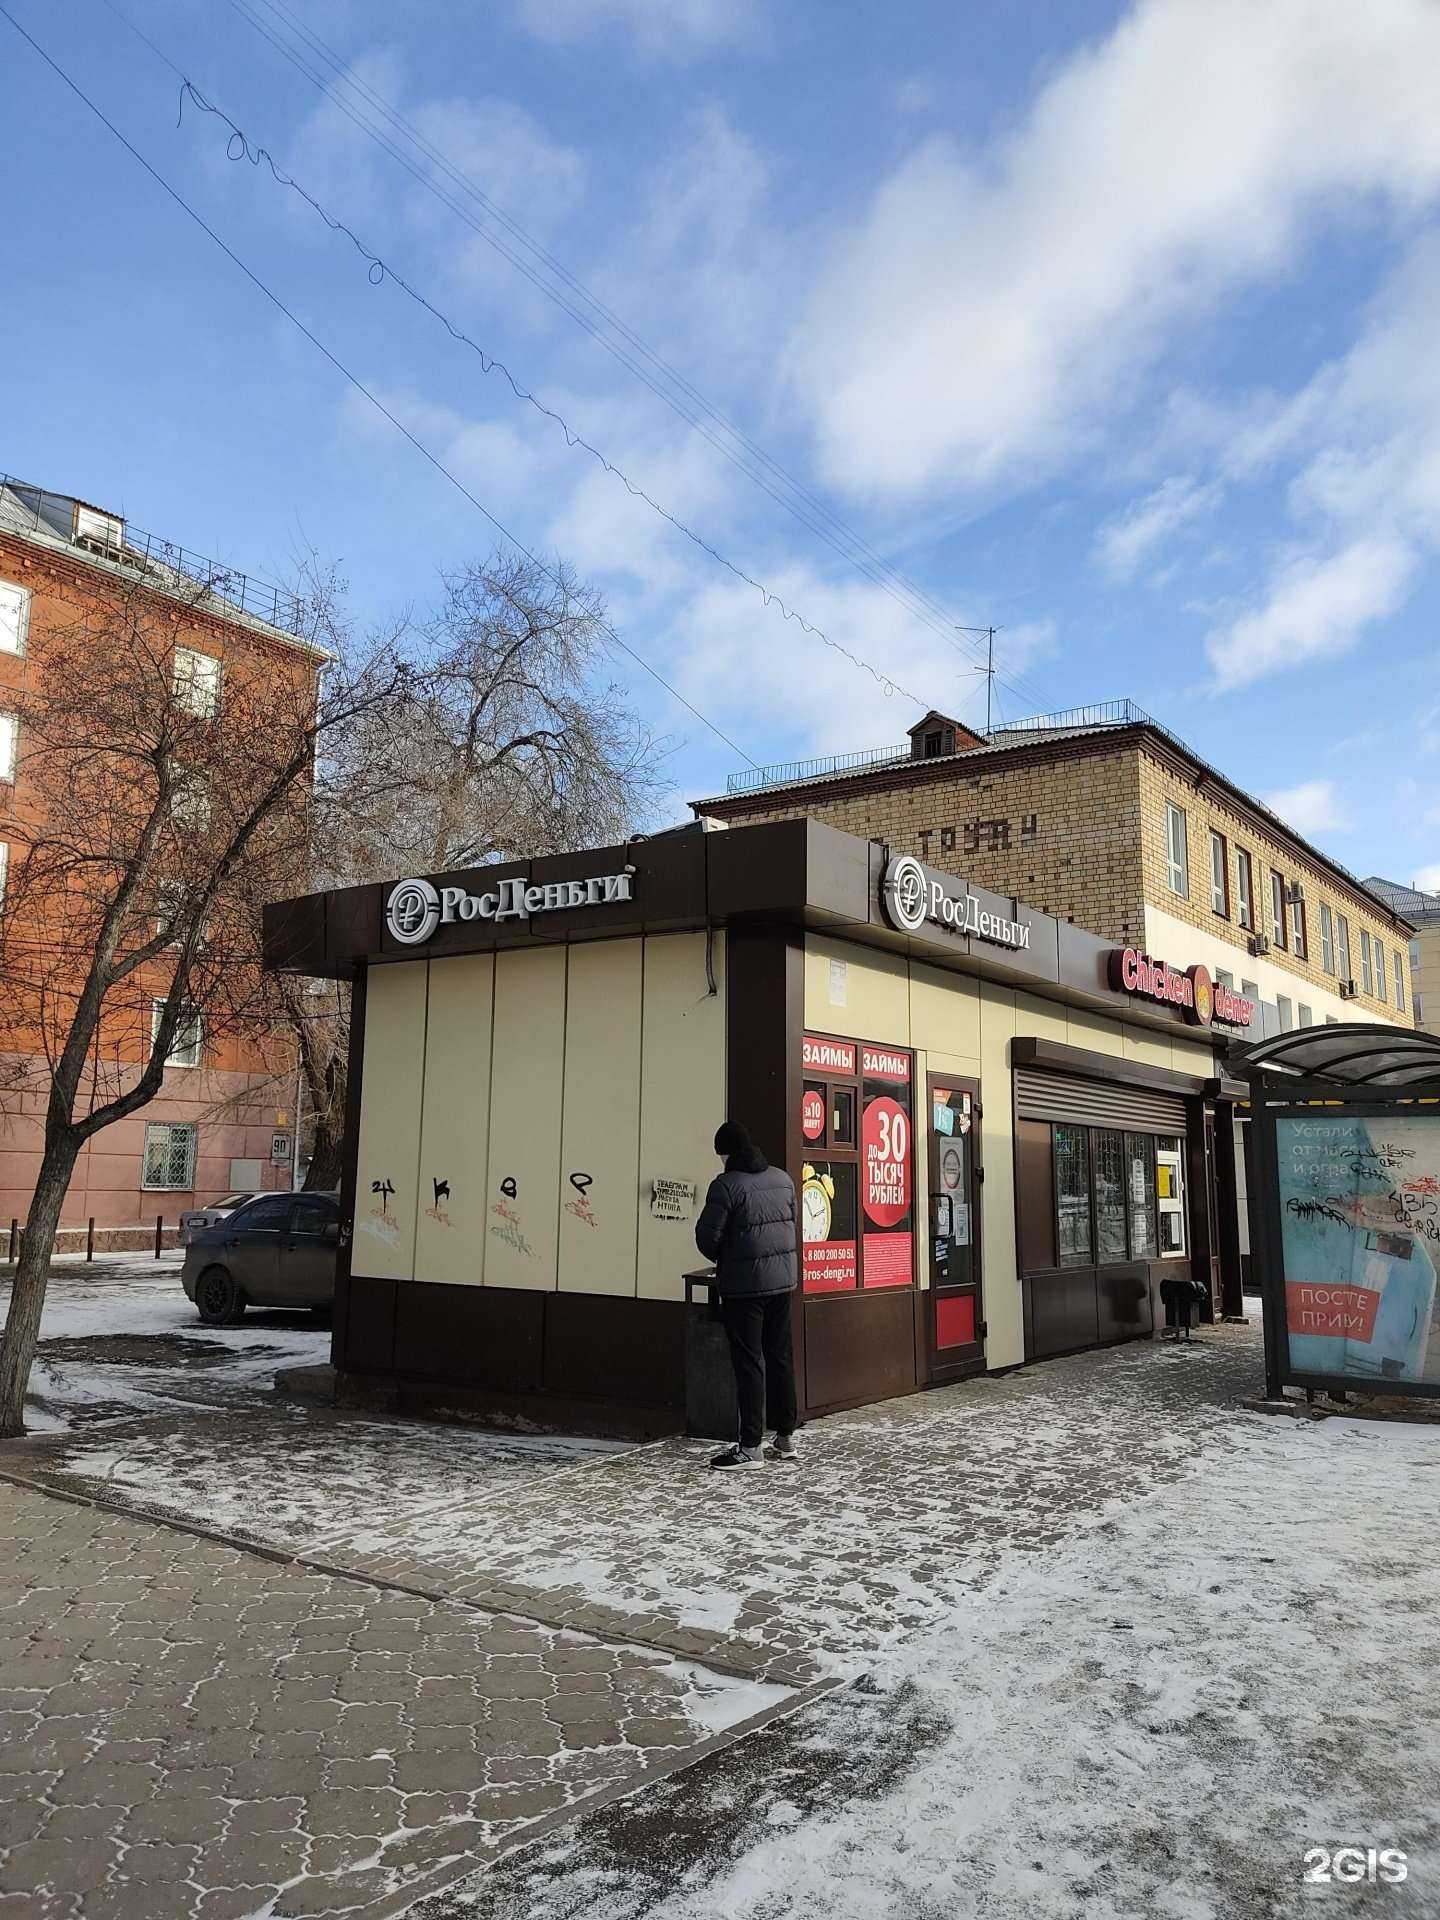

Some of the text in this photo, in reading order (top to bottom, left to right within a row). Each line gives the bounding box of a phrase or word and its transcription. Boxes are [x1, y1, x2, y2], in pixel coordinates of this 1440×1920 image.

[1122, 947, 1193, 1008] Chicken
[803, 1044, 853, 1069] ЗАЙМЫ
[863, 1053, 907, 1076] ЗАЙМЫ
[811, 1102, 820, 1118] 10
[868, 1111, 906, 1163] ДО 30
[868, 1161, 904, 1186] ТЫСЯЧ
[870, 1184, 904, 1205] РУБЛЕЙ
[813, 1249, 826, 1260] 800
[825, 1249, 838, 1260] 200
[838, 1248, 846, 1259] 50
[846, 1248, 854, 1259] 51
